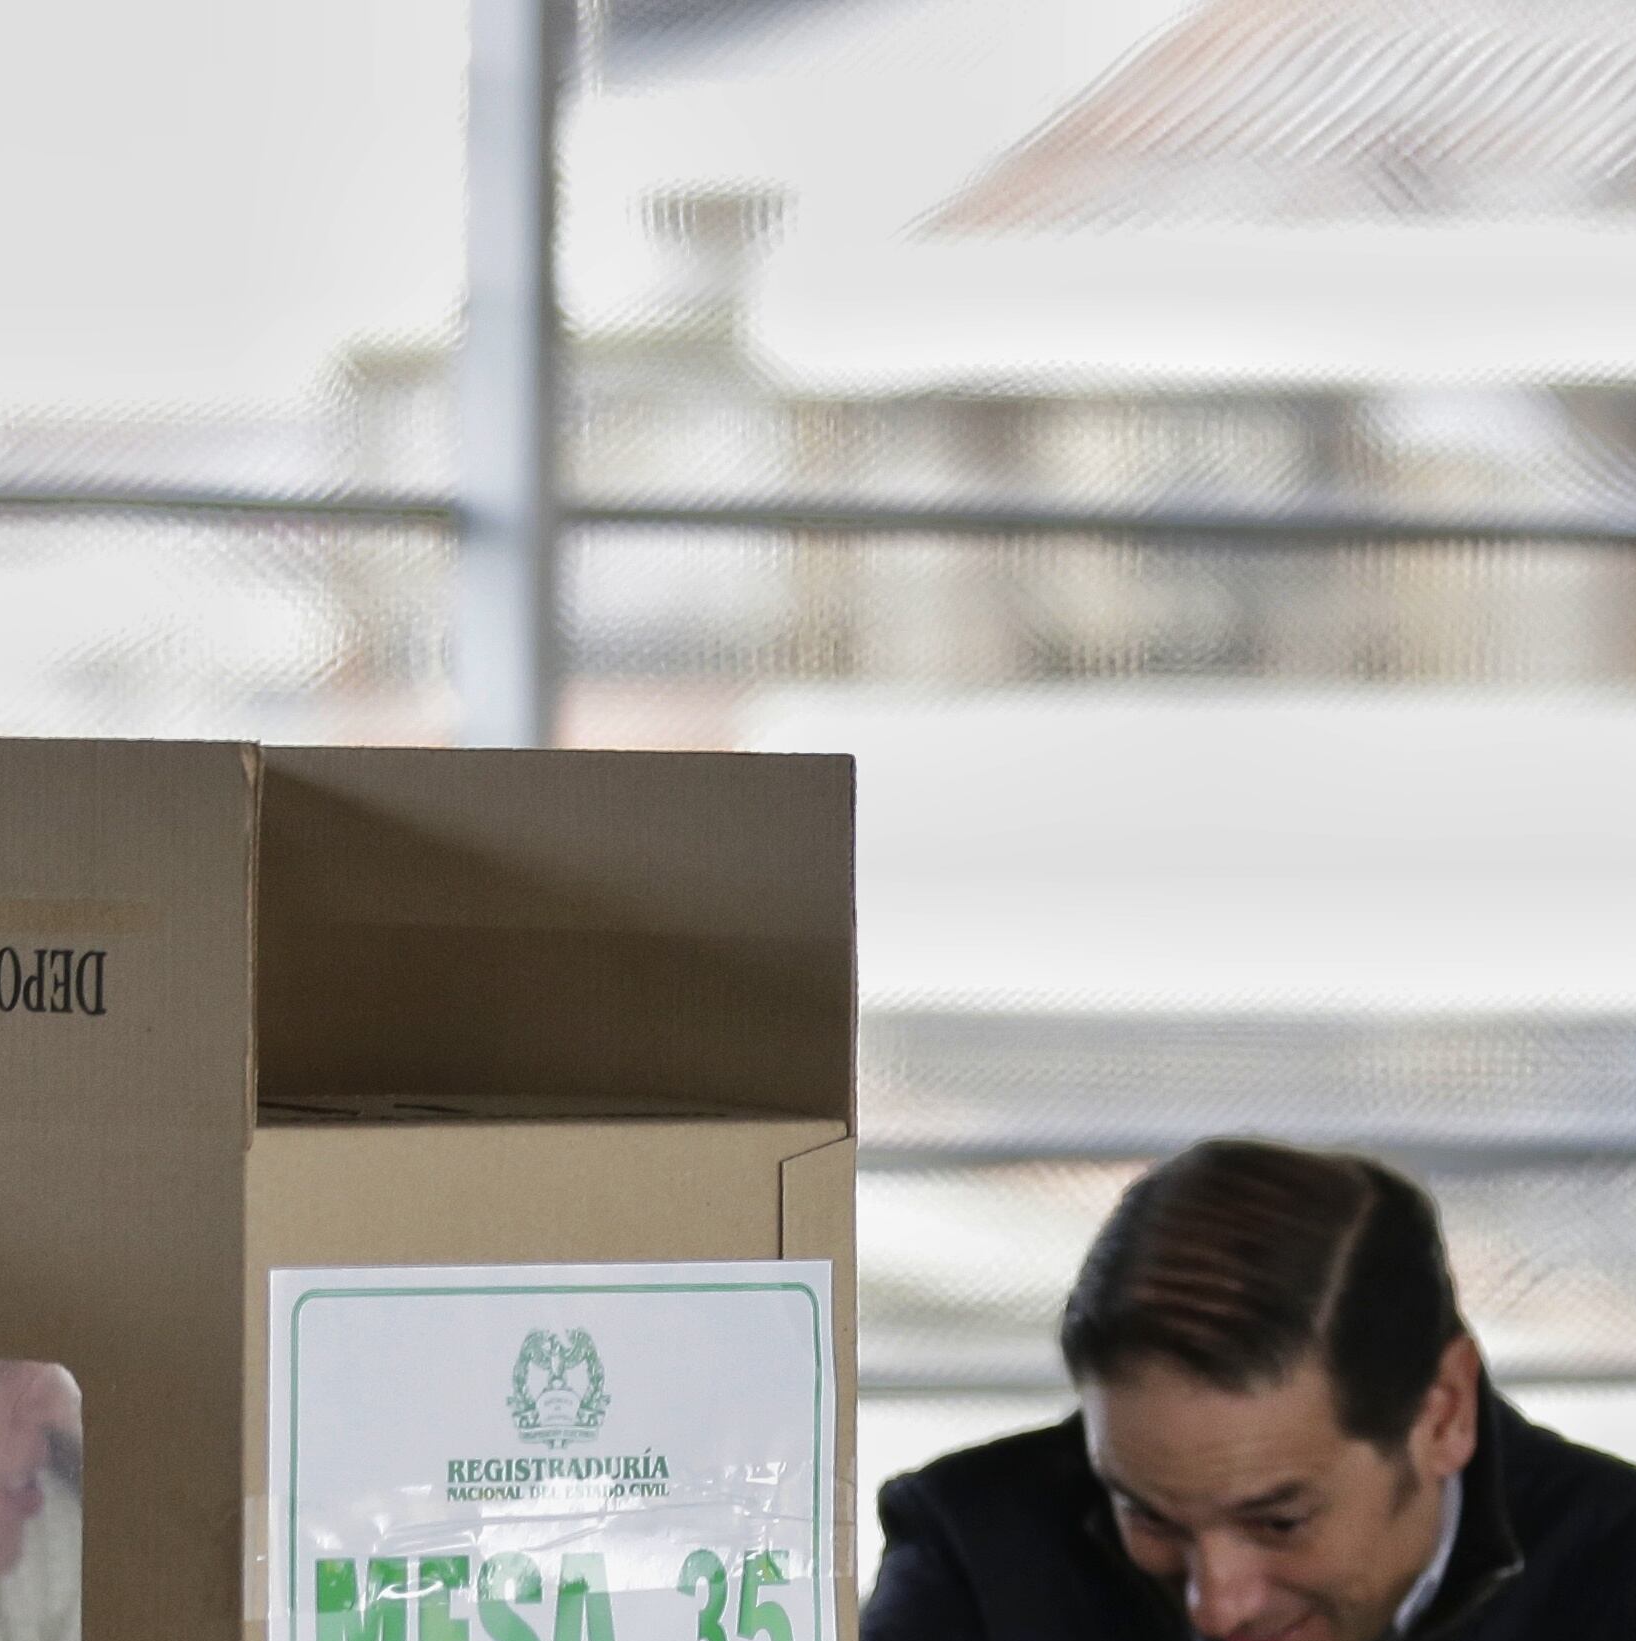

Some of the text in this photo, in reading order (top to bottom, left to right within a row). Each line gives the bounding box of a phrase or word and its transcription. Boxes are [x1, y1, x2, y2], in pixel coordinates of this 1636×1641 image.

[447, 1447, 670, 1485] REGISTRADURÍA
[447, 1486, 522, 1502] NACIONAL
[629, 1481, 670, 1498] CIVIL
